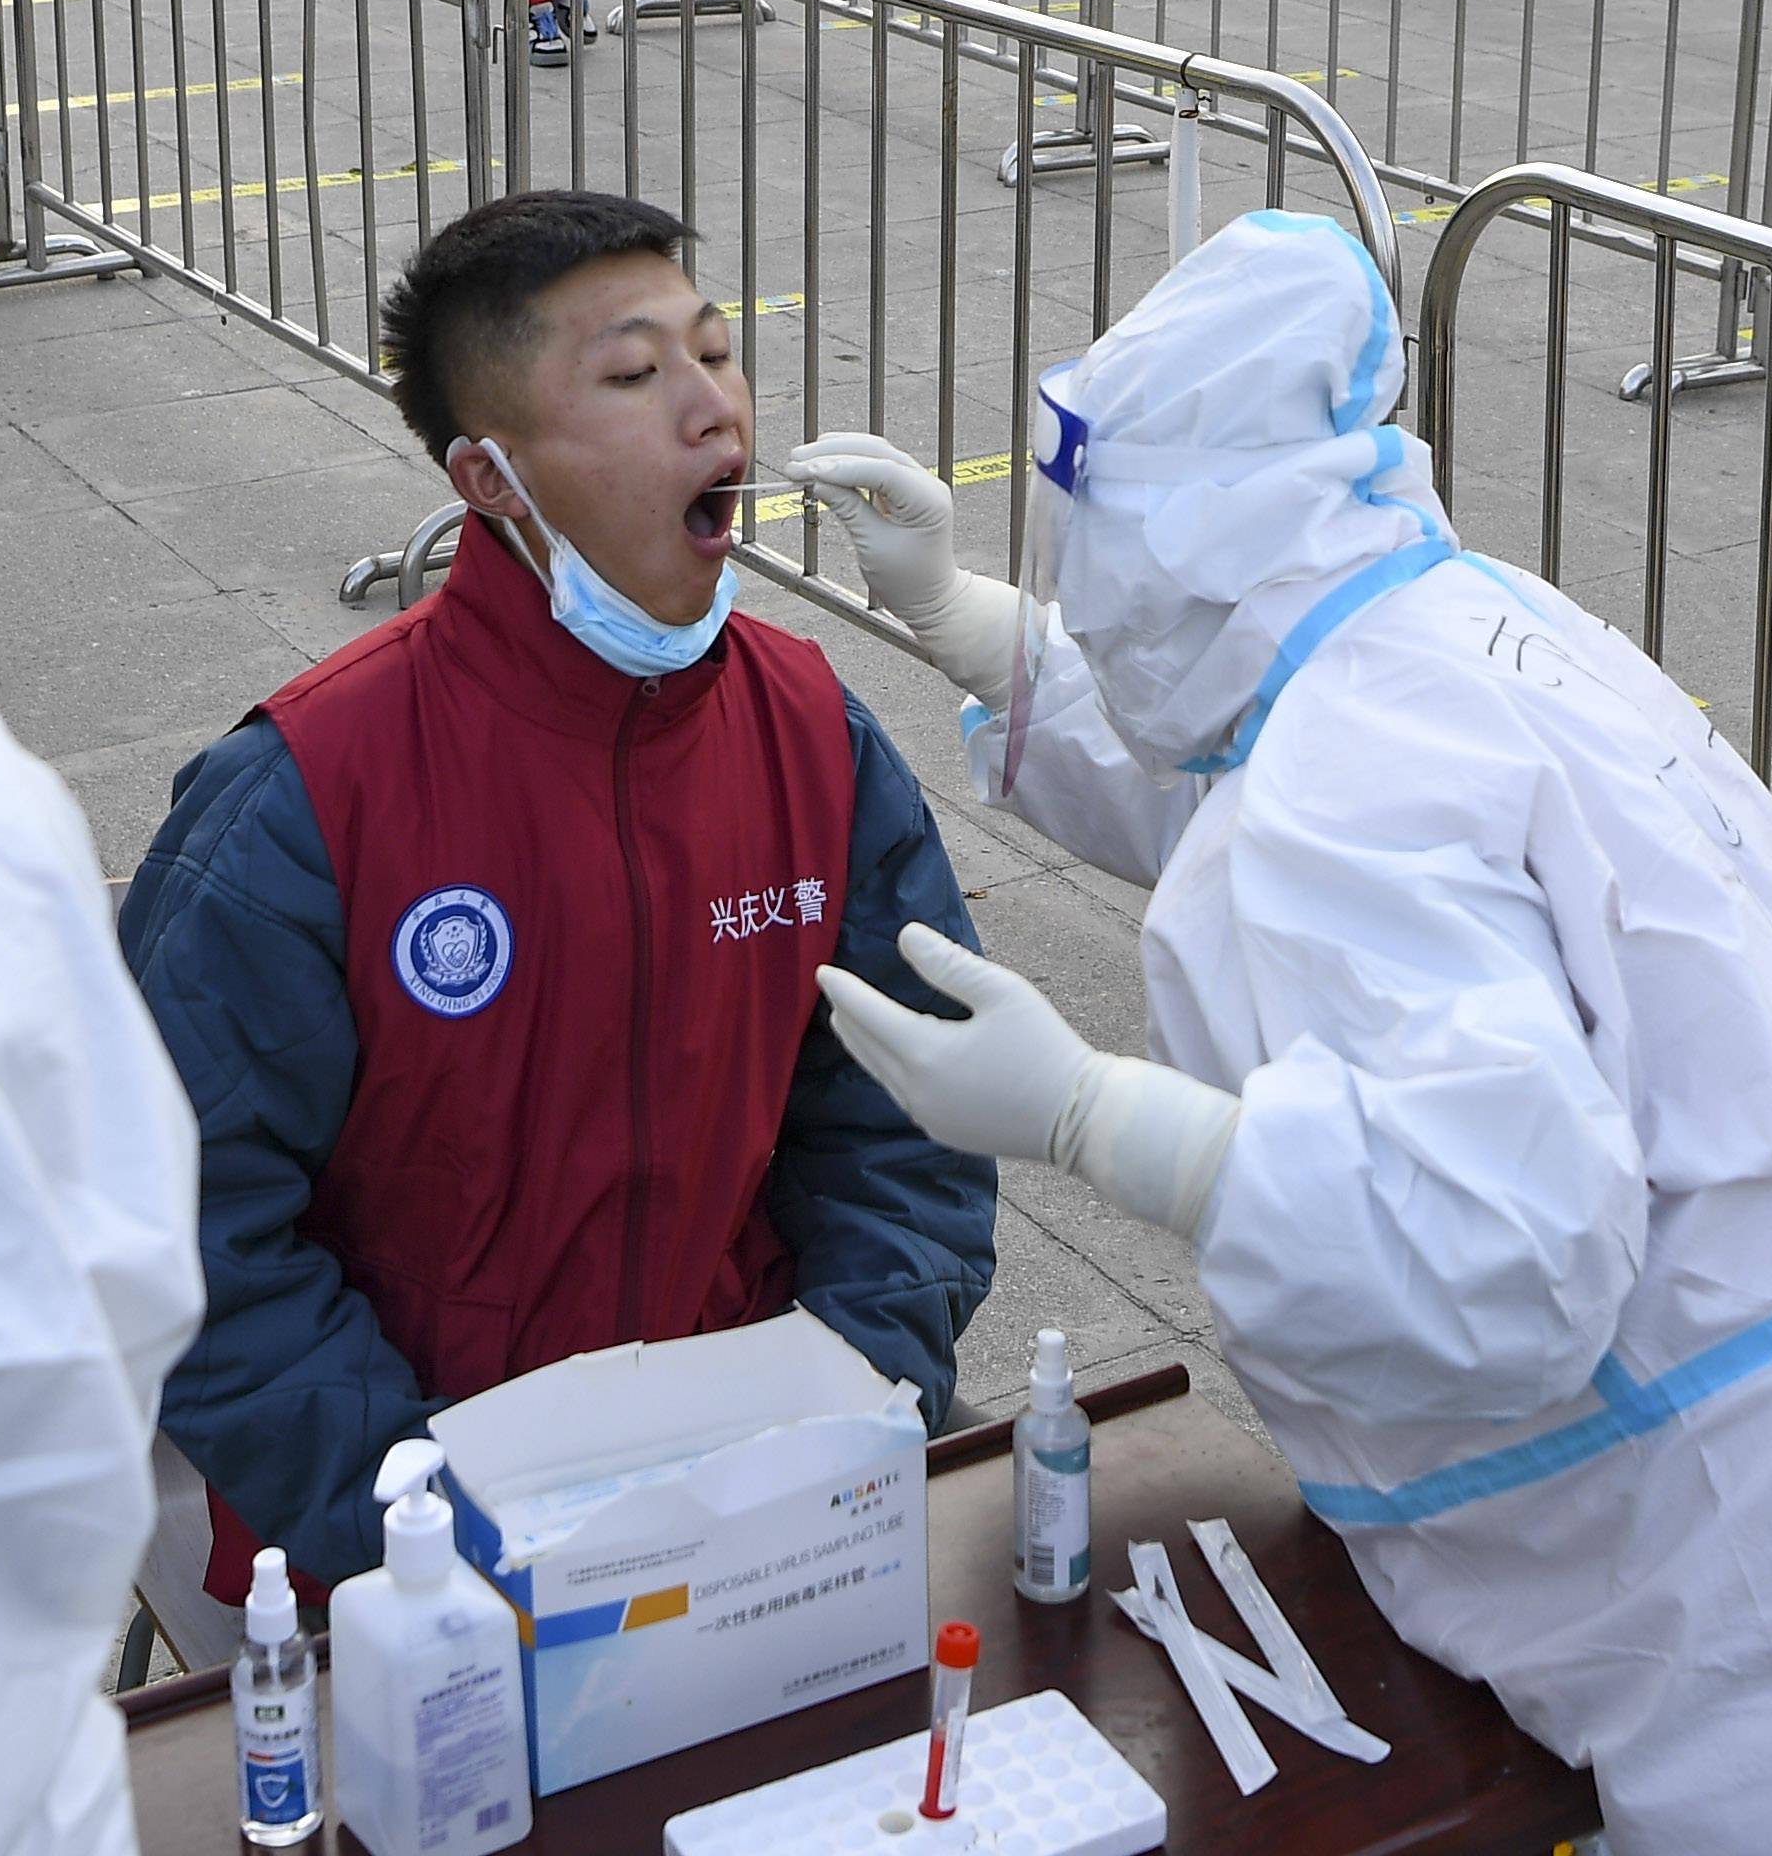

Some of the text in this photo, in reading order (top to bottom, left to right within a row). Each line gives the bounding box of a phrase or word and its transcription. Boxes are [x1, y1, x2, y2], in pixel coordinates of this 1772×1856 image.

[709, 876, 828, 945] 兴庆义警
[409, 973, 436, 1003] XING
[438, 996, 471, 1012] QING
[485, 962, 506, 994] JING
[694, 1560, 773, 1601] DISPOSABLE
[775, 1549, 812, 1574] VIRUS
[812, 1527, 874, 1560] SAMPLING
[876, 1510, 906, 1537] TUBE
[697, 1564, 867, 1632] 一次性使用病毒采样管
